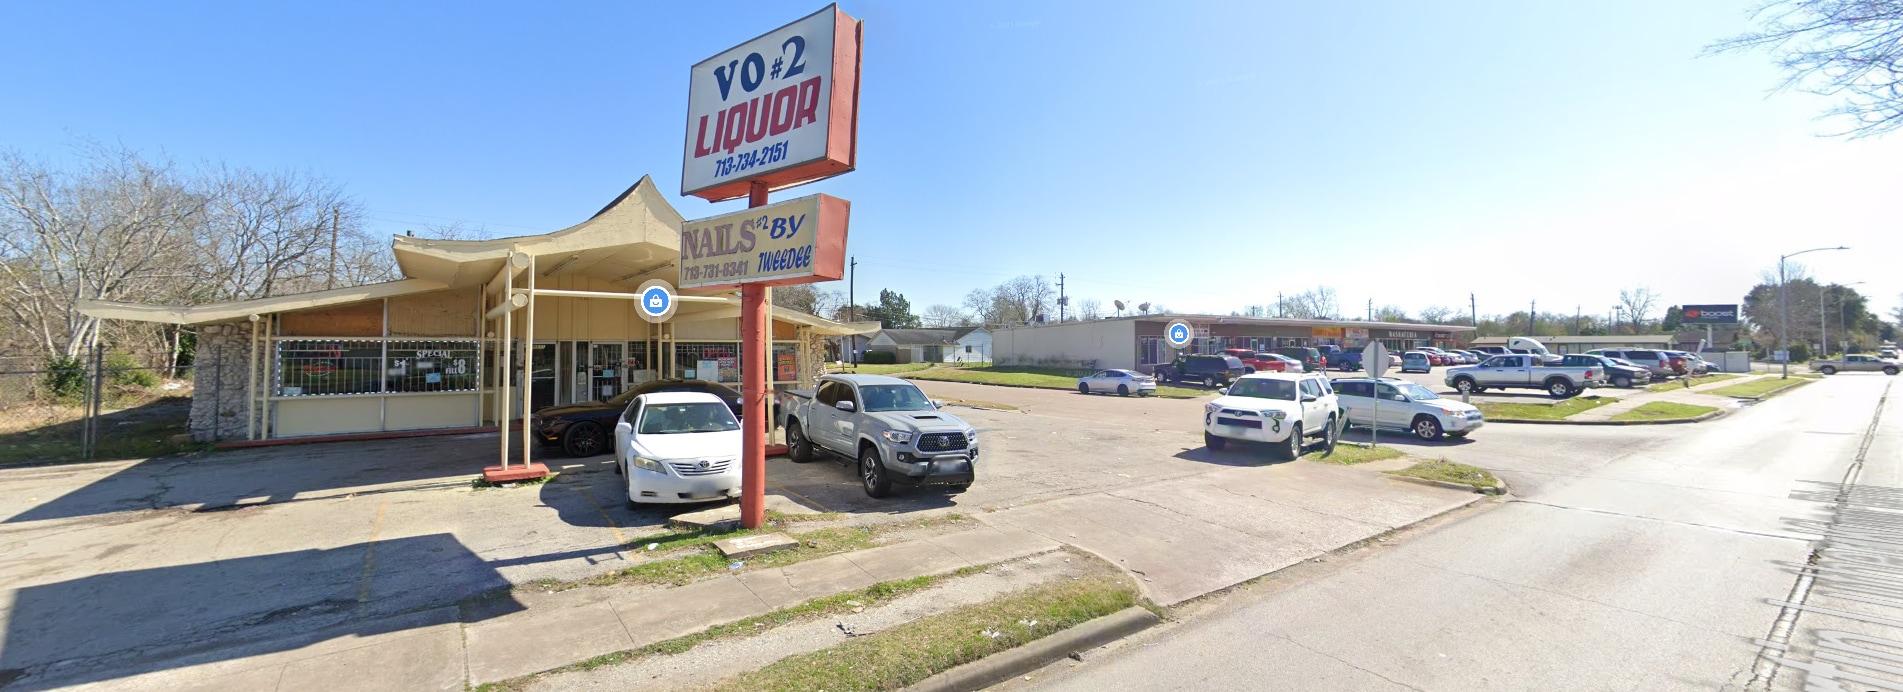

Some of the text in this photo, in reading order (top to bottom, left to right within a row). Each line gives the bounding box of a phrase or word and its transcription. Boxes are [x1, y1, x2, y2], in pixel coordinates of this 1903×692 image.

[713, 35, 807, 102] VO #2
[694, 75, 822, 159] LIQUOR
[714, 140, 789, 178] 713-734-2151
[681, 219, 756, 260] NAILS
[757, 244, 812, 273] TWEEDEE
[684, 260, 749, 281] 713-731-8341
[415, 349, 452, 360] SPECIAL
